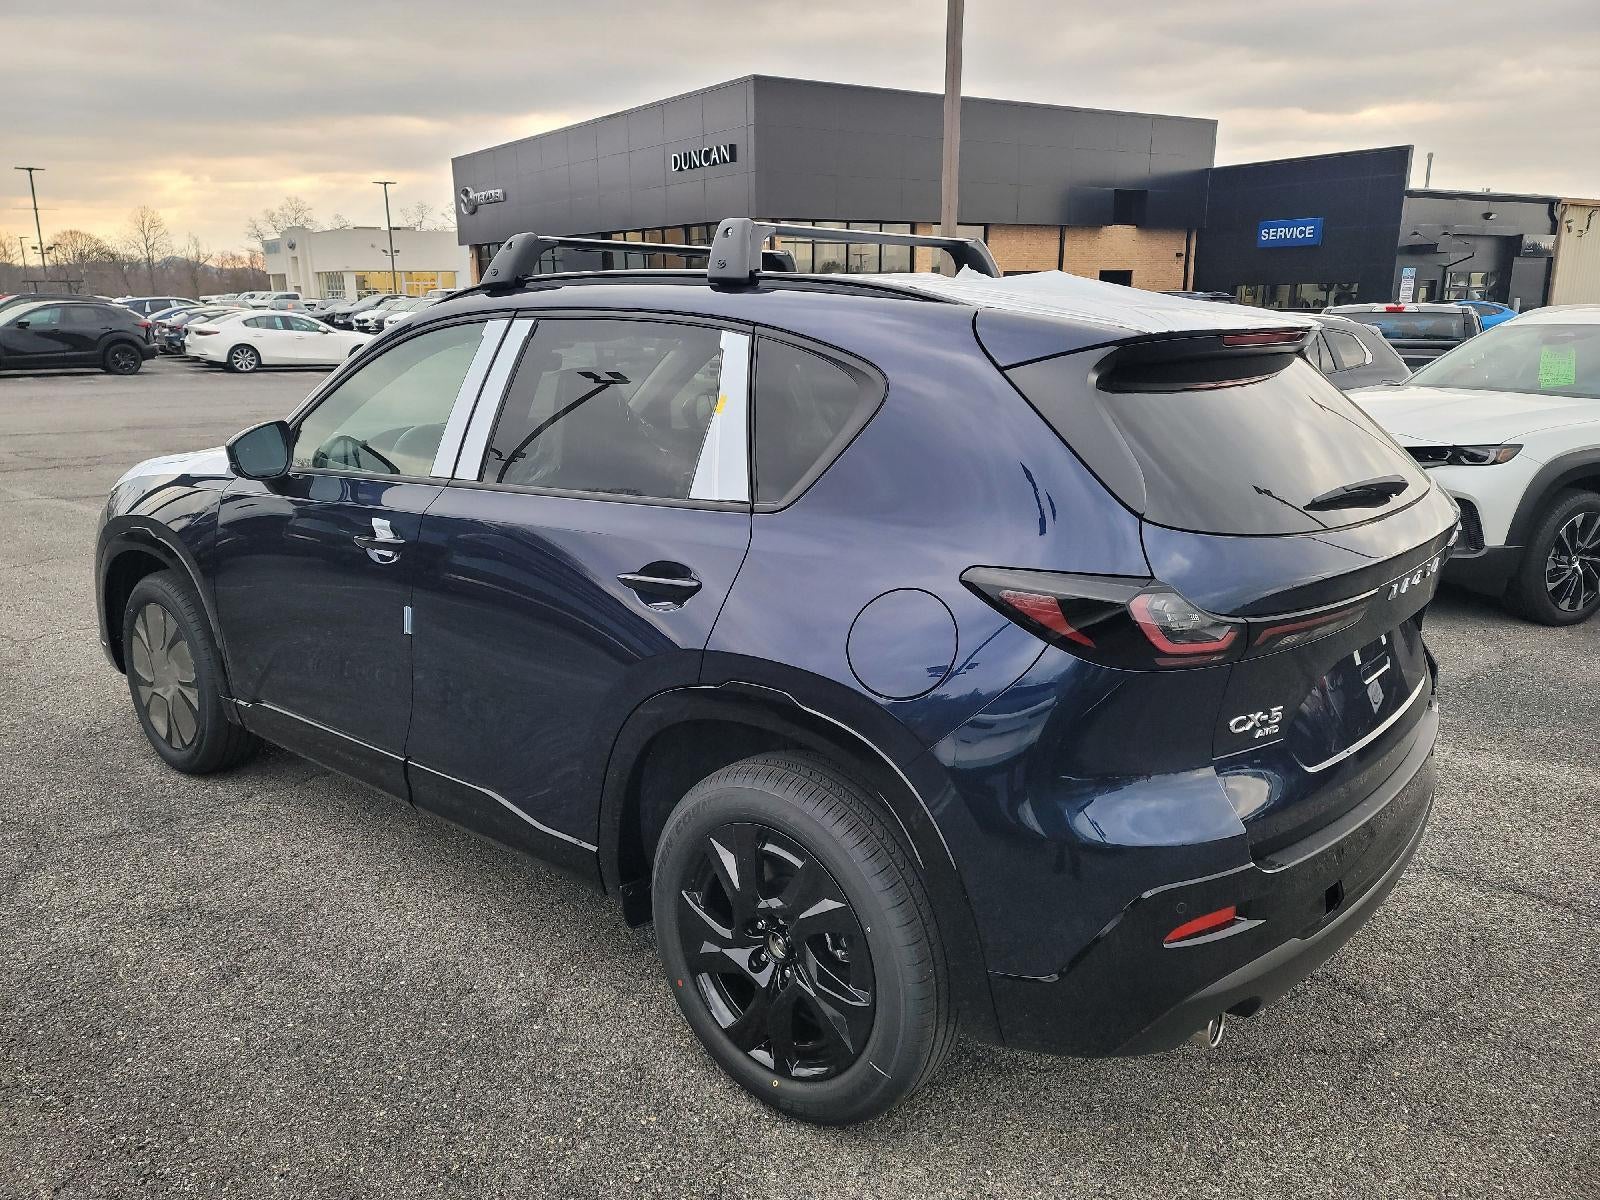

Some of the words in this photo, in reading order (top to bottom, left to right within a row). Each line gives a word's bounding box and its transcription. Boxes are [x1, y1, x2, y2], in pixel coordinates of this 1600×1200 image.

[671, 143, 731, 172] DUNCAN
[1260, 225, 1315, 241] SERVICE
[1229, 705, 1284, 734] CX-5
